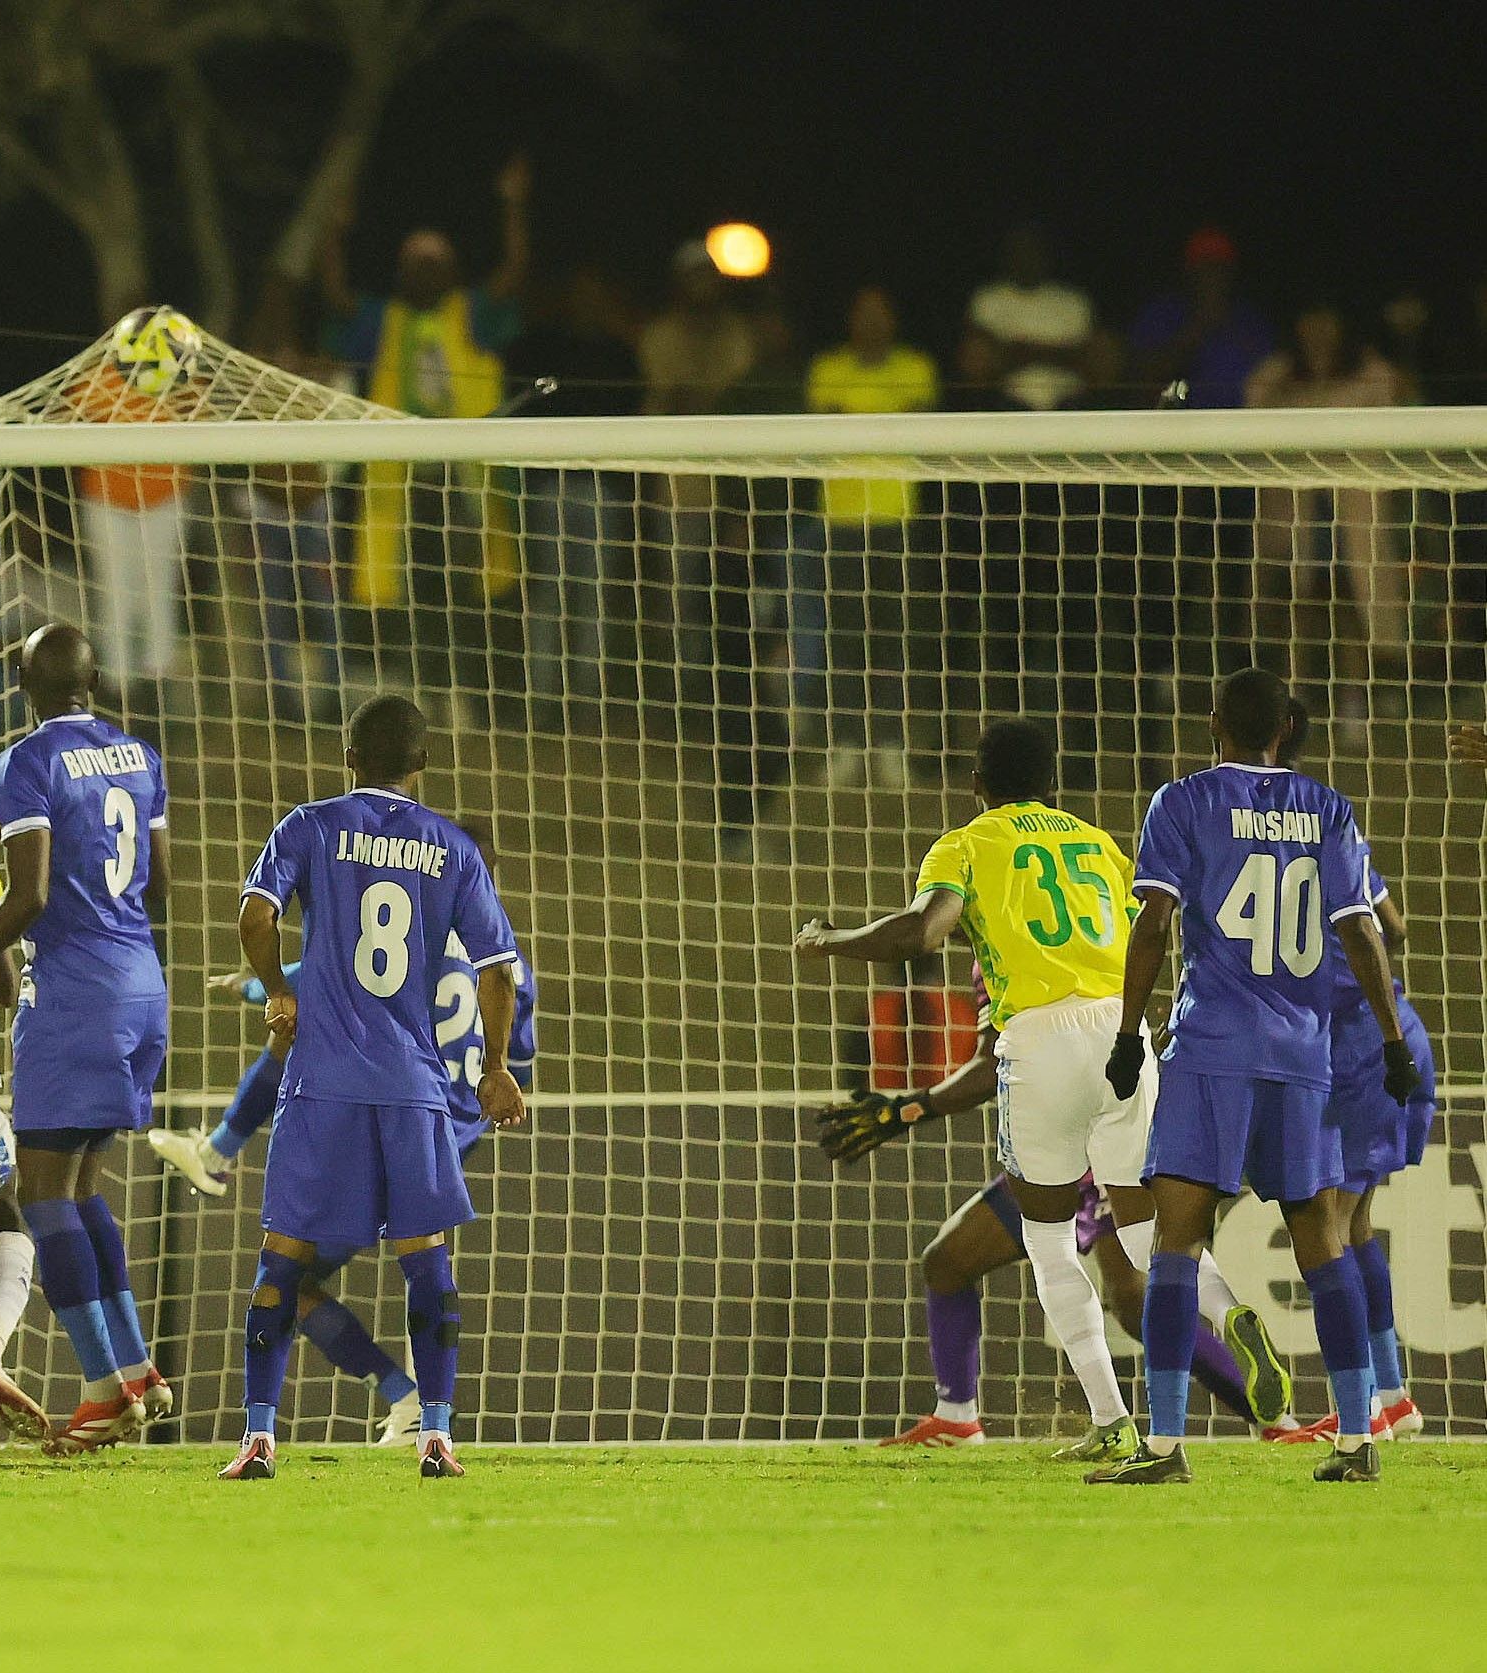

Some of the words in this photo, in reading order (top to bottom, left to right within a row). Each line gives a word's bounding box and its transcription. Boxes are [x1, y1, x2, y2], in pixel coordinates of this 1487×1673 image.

[103, 787, 138, 898] 3
[336, 830, 447, 879] J.MOKONE
[1009, 813, 1081, 833] MOTHIBA
[1231, 808, 1322, 844] MOSADI
[353, 881, 412, 998] 8
[1013, 843, 1115, 947] 35
[1215, 853, 1324, 978] 40
